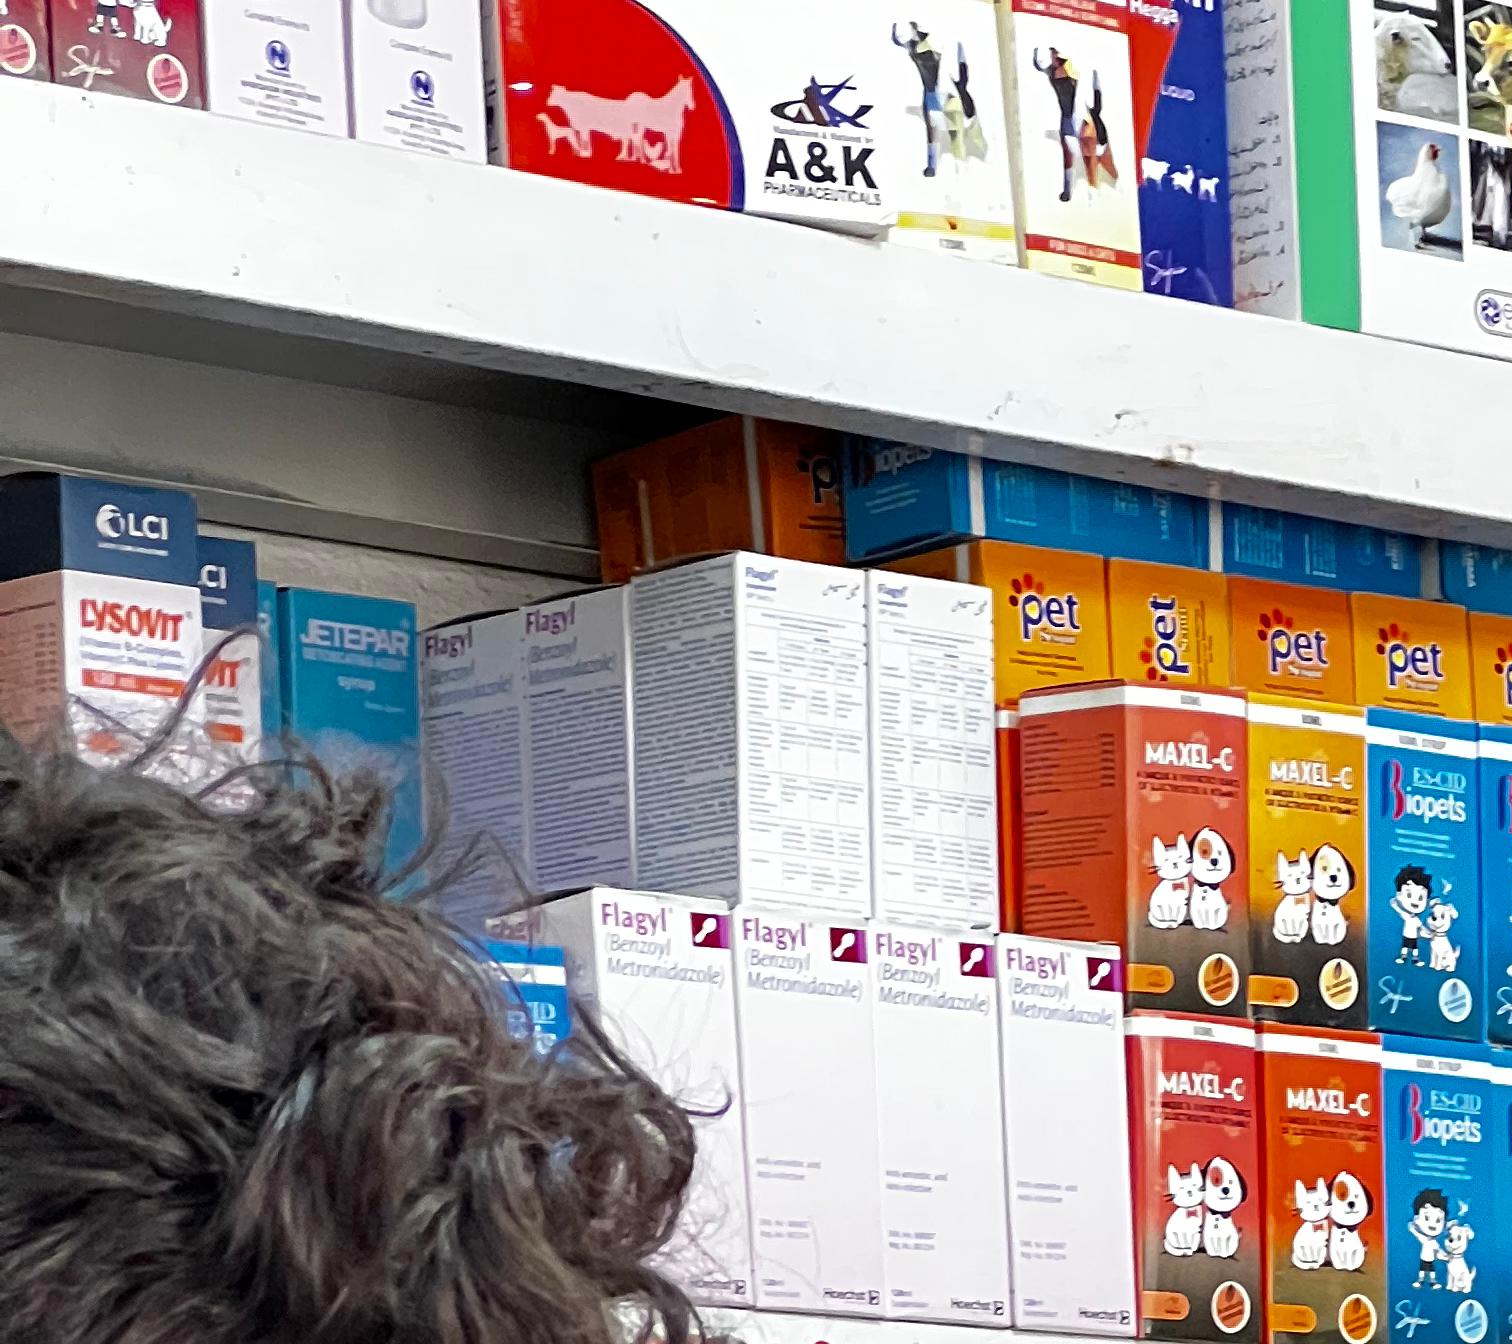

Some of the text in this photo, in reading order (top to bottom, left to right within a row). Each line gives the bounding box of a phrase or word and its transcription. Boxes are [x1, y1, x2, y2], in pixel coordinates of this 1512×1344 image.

[766, 138, 878, 189] A&K
[764, 182, 881, 206] PHARMACEUTICALS
[128, 512, 169, 541] LCI
[199, 563, 228, 590] CI
[80, 598, 185, 642] LYSOVIT
[525, 601, 576, 635] Flagyl
[1021, 592, 1082, 643] pet
[301, 618, 409, 657] JETEPAR
[425, 625, 473, 658] Flagyl
[1149, 593, 1191, 676] pet
[1270, 627, 1330, 676] pet
[1387, 639, 1446, 689] pet
[1145, 741, 1234, 772] MAXEL-C
[1269, 759, 1353, 790] MAXEL-C
[601, 903, 667, 936] Flagyl
[742, 918, 807, 950] Flagyl
[606, 932, 671, 960] (Benzoyl
[745, 947, 811, 972] (Benzoyl
[876, 933, 938, 965] Flagyl
[607, 957, 725, 989] Metronidazole)
[878, 962, 940, 988] (Benzoyl
[1006, 948, 1068, 979] Flagyl
[747, 971, 863, 1003] Metronidazole)
[879, 986, 990, 1017] Metronidazole)
[1008, 976, 1070, 1001] (Benzoyl
[1010, 1000, 1116, 1029] Metronidazole)
[1157, 1071, 1244, 1102] MAXEL-C
[1286, 1088, 1370, 1117] MAXEL-C
